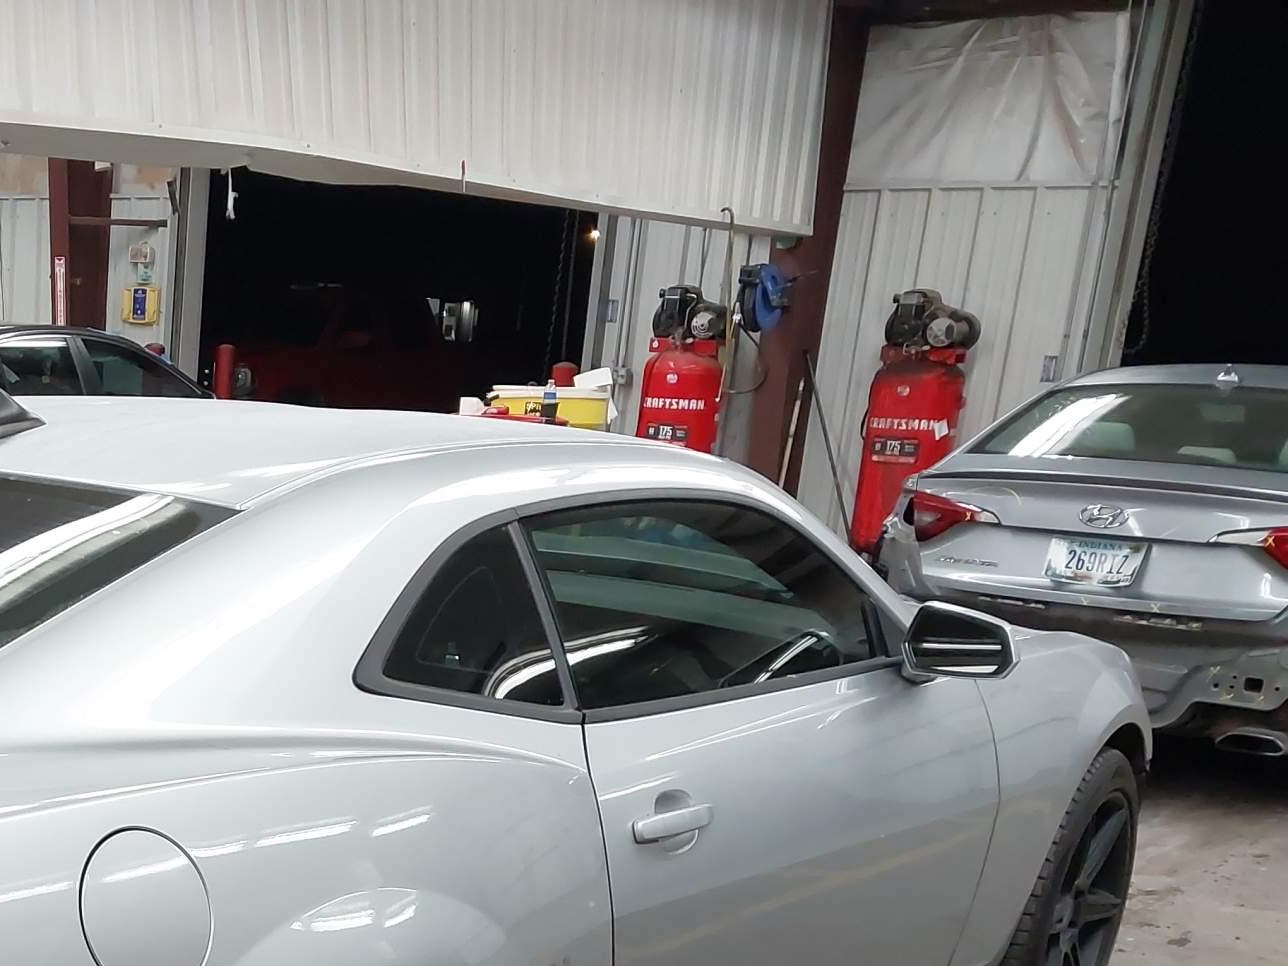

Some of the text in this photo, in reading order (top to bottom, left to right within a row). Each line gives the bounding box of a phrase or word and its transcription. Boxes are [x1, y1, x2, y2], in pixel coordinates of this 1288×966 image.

[643, 397, 705, 410] CRAFTSMAN
[659, 425, 673, 436] 175
[887, 440, 901, 453] 175
